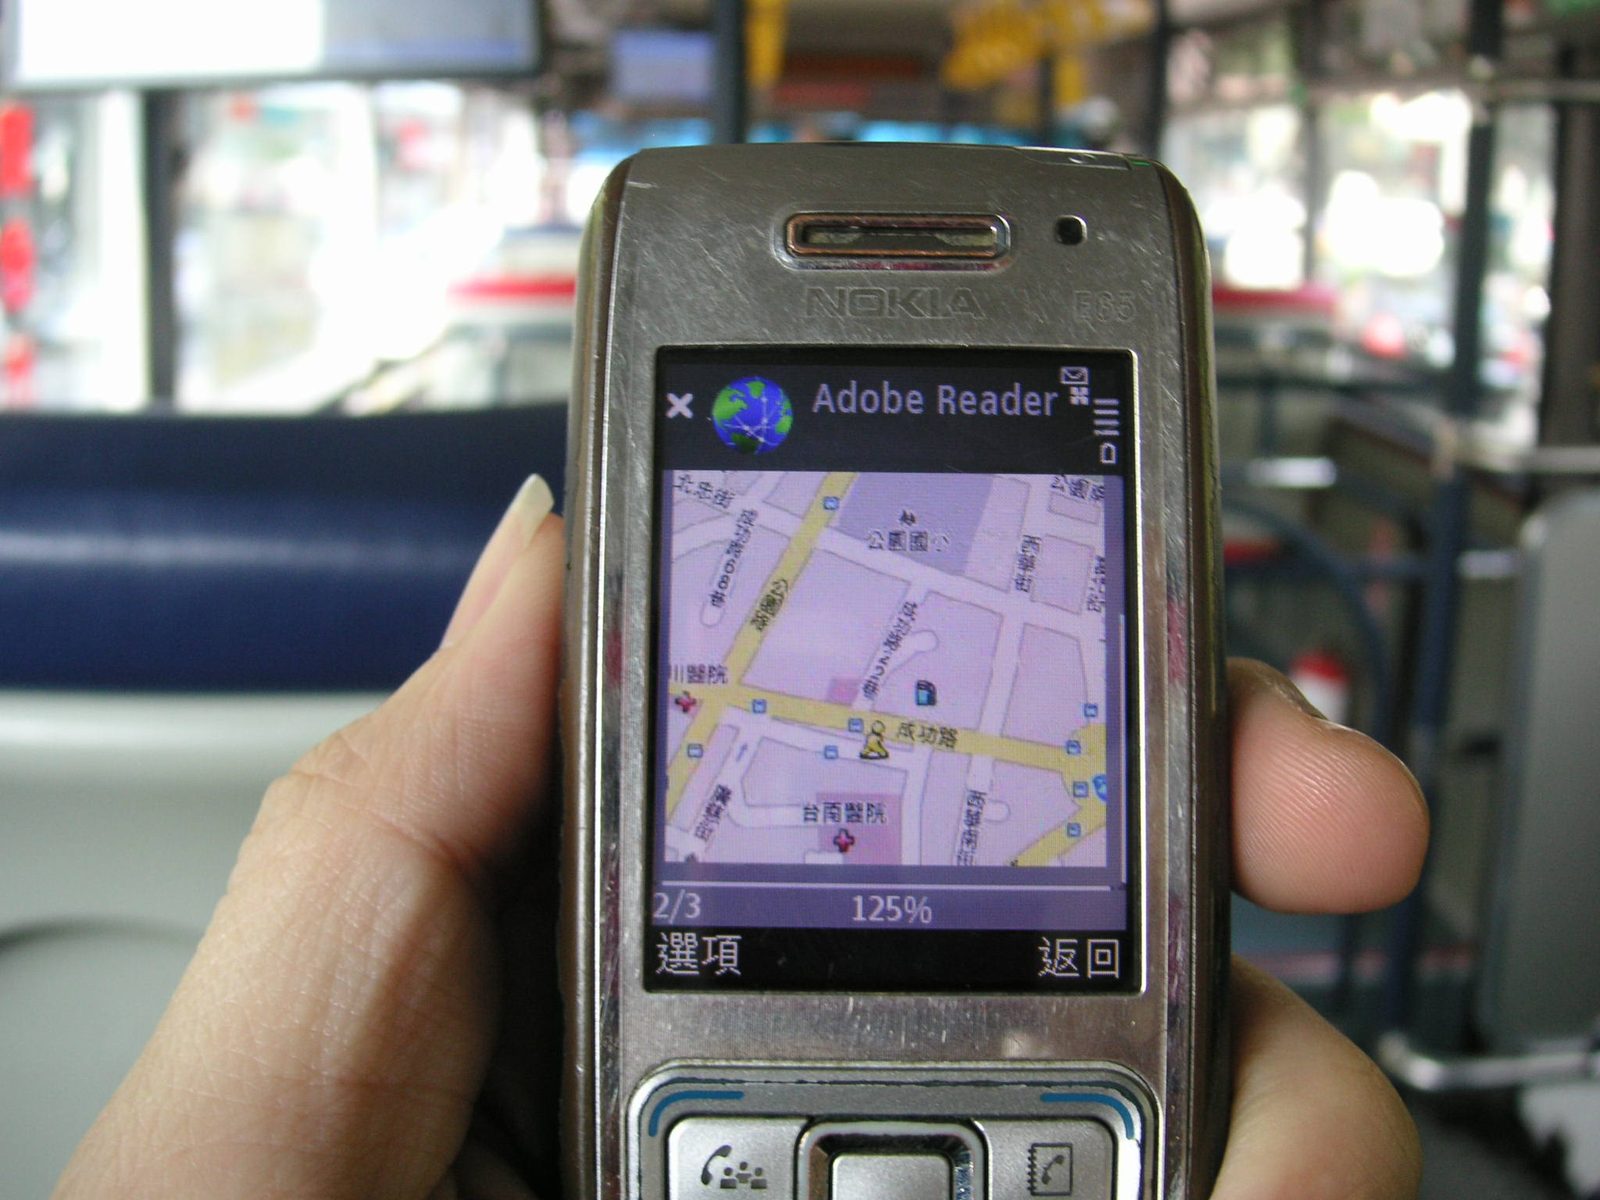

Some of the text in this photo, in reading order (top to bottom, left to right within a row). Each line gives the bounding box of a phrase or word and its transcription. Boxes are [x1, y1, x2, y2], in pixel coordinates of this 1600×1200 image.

[803, 286, 988, 321] NOKIA
[1073, 289, 1138, 323] E65
[812, 380, 1058, 417] Adobe Reader
[897, 721, 958, 749] 成功路
[803, 801, 888, 824] 台南醫院
[652, 893, 702, 923] 2/3
[851, 895, 933, 925] 125%
[655, 931, 742, 976] 選項
[1037, 936, 1121, 979] 返回
